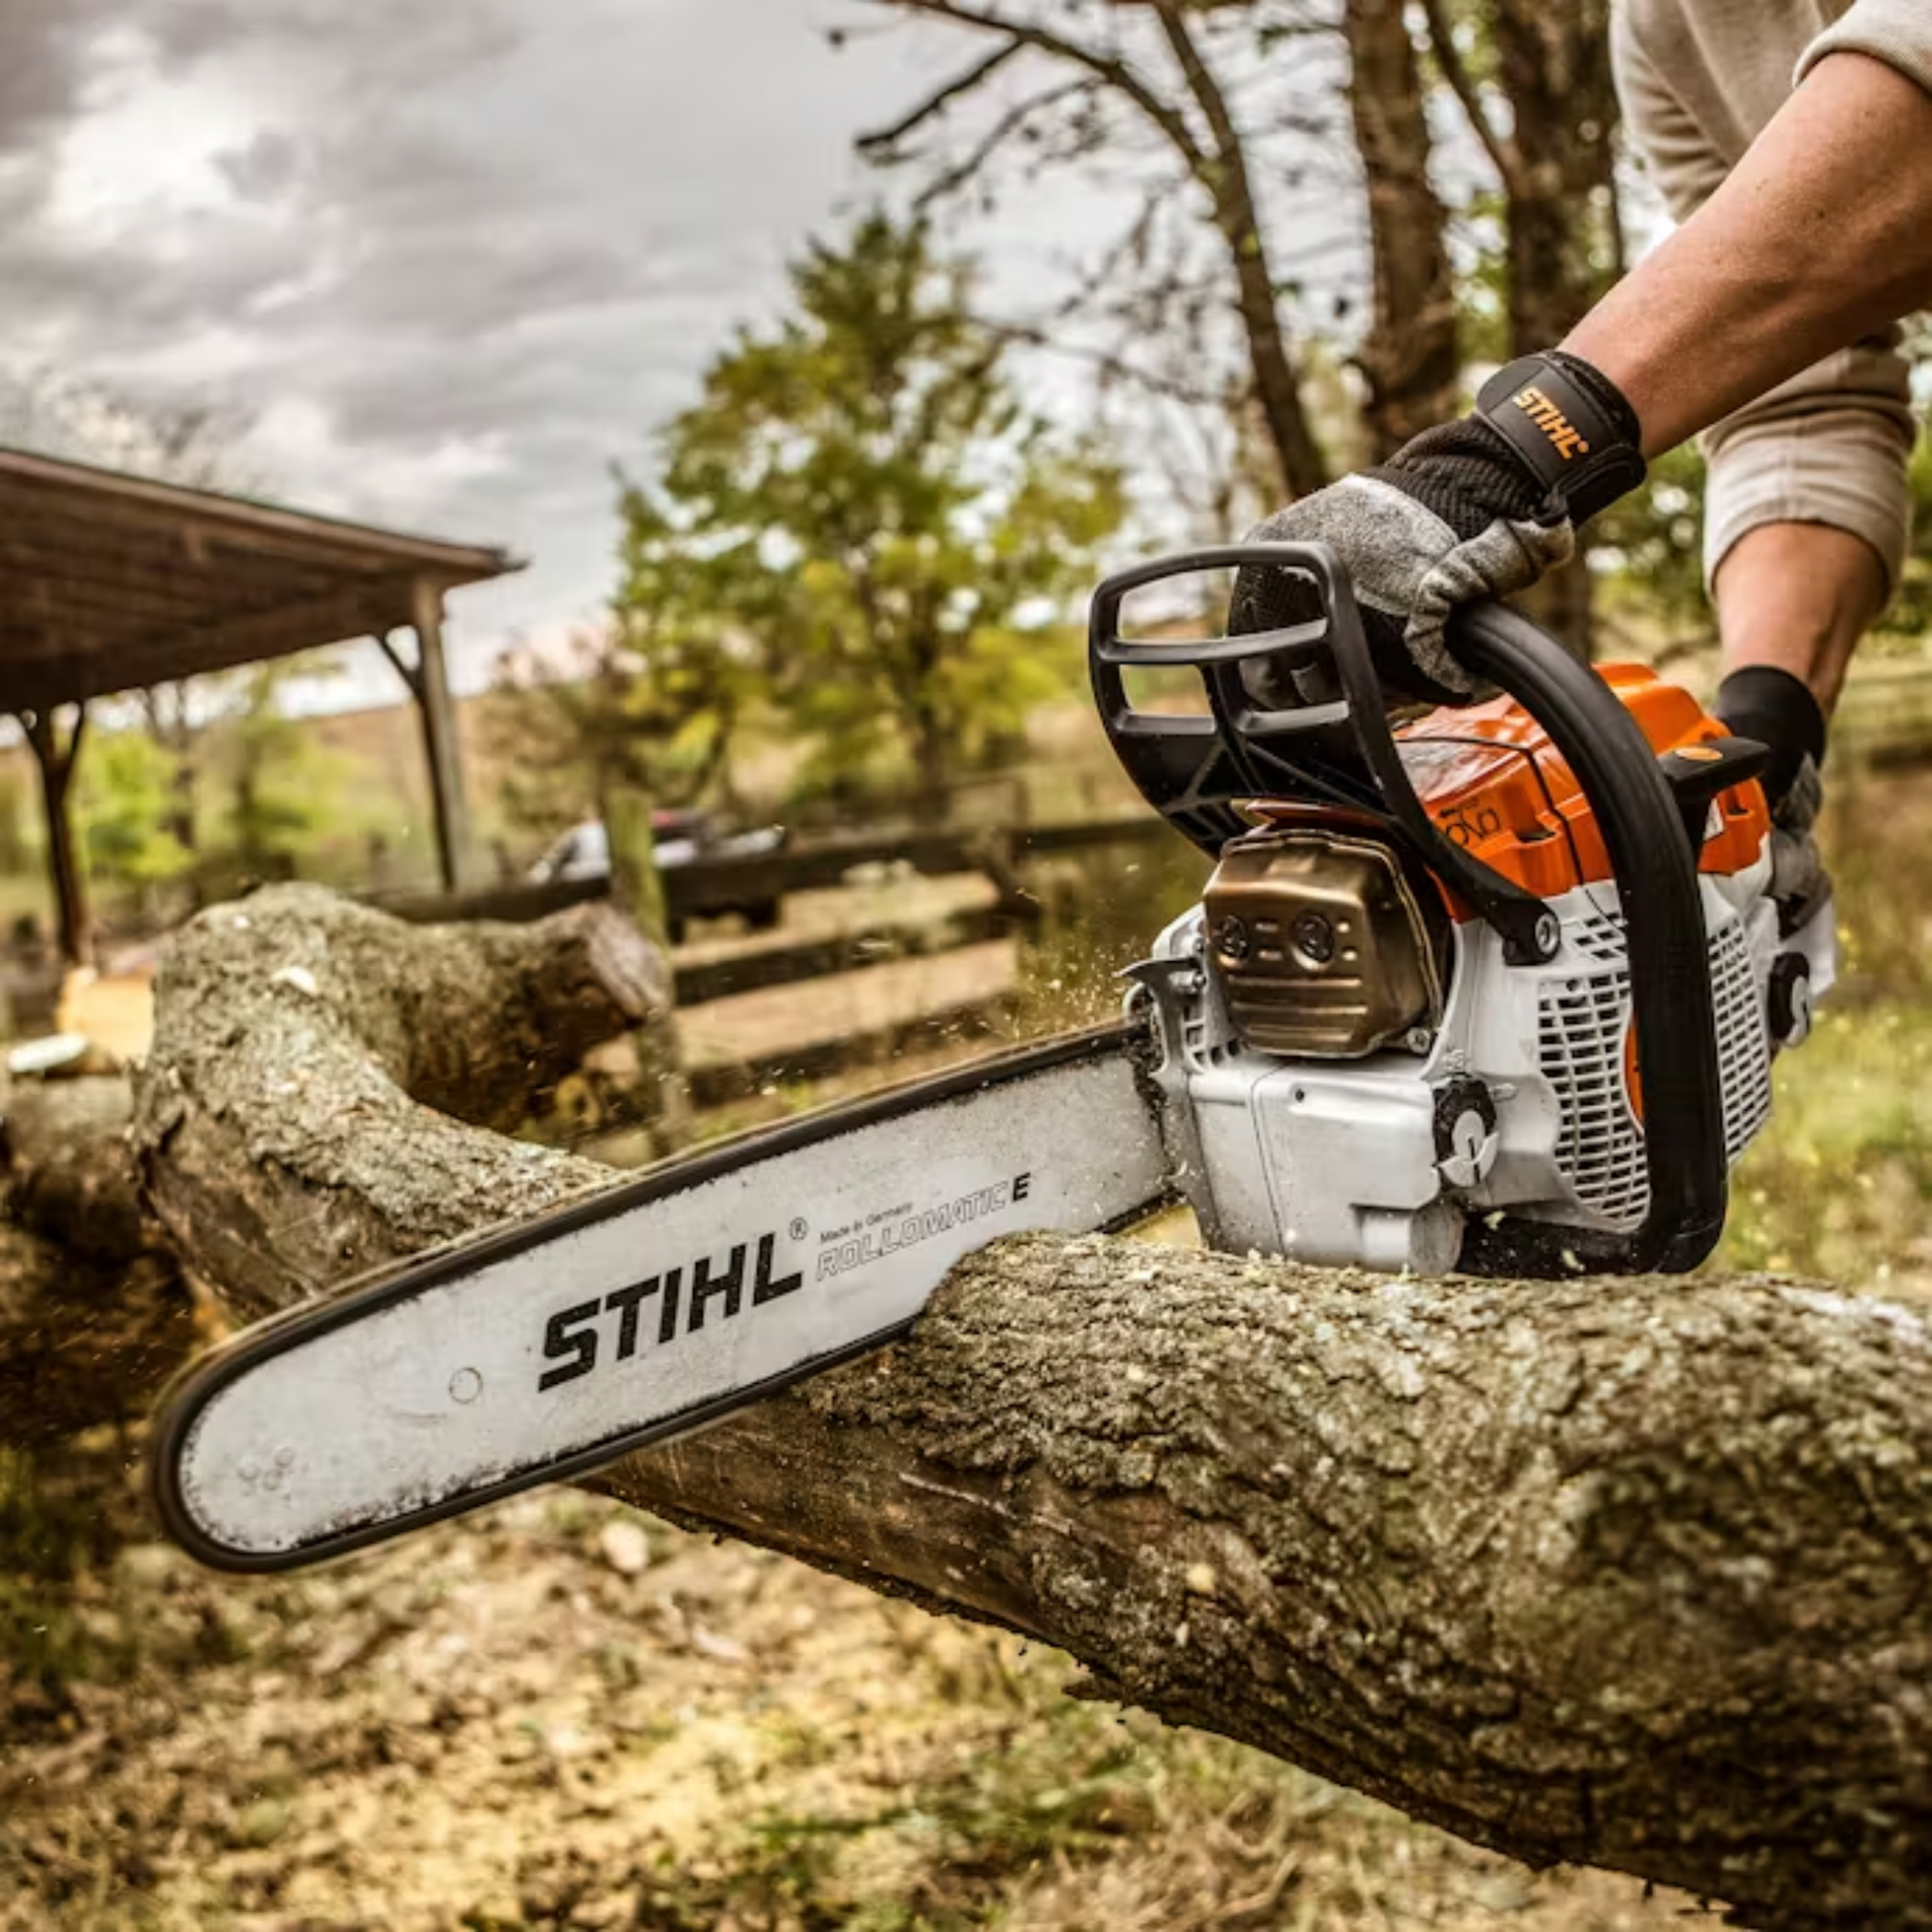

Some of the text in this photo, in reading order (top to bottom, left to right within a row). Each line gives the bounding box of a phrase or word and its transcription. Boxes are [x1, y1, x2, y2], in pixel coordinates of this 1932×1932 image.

[1512, 385, 1581, 460] STIHL
[816, 1172, 1032, 1283] ROLLOMATIC E
[538, 1232, 803, 1393] STIHL
